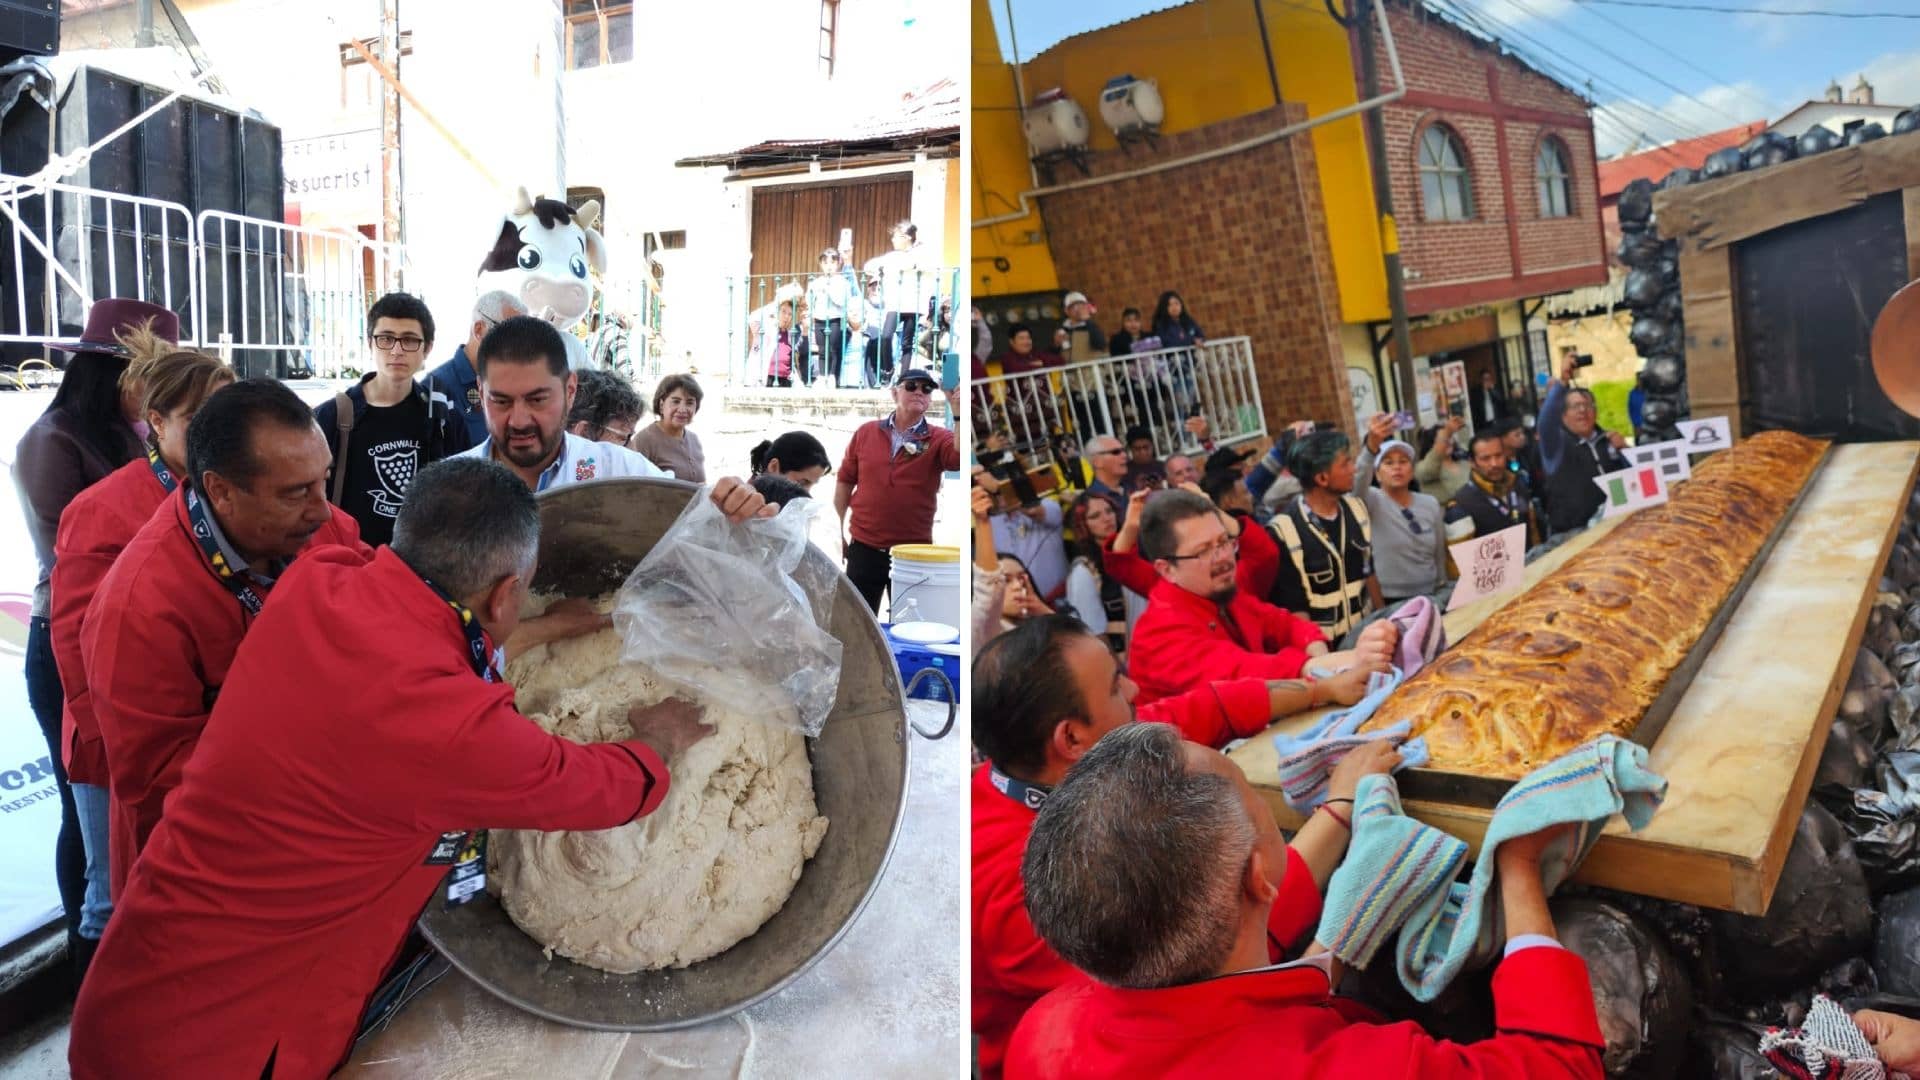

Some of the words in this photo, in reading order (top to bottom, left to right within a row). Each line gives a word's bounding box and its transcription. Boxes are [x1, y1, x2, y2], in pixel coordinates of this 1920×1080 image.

[288, 163, 371, 194] esucrist
[367, 439, 421, 456] CORNWALL
[378, 504, 397, 514] ONE
